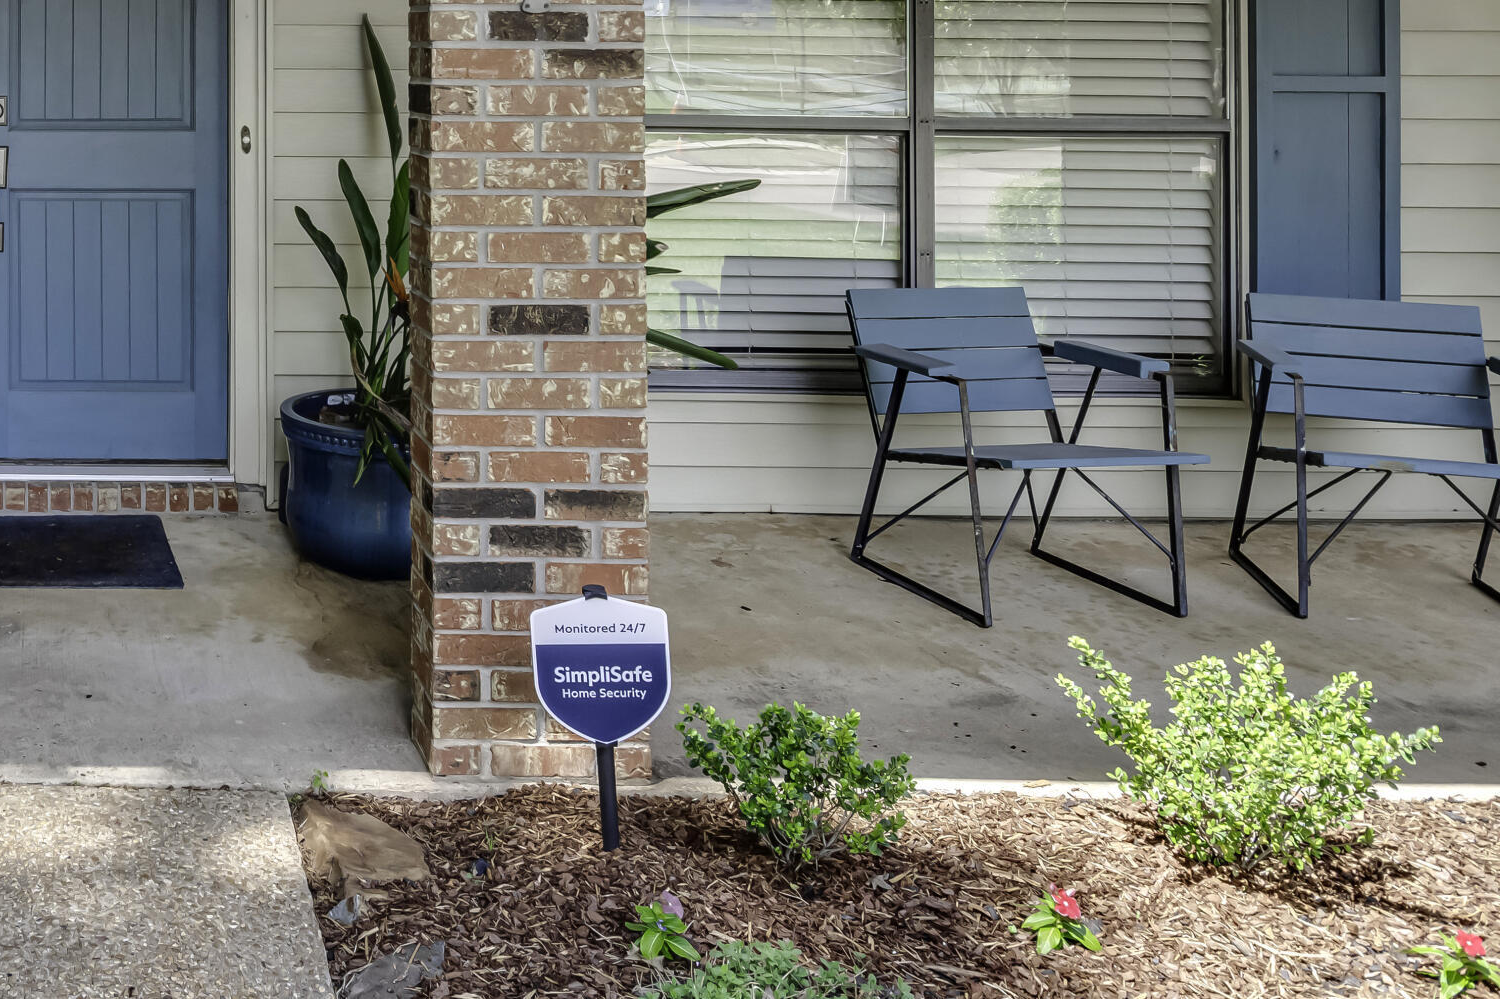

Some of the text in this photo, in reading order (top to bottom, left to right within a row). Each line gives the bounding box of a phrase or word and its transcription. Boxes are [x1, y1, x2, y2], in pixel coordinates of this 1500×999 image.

[554, 623, 646, 634] Monitored 24/7
[553, 665, 653, 687] SimpliSafe
[562, 687, 647, 700] Home Security
